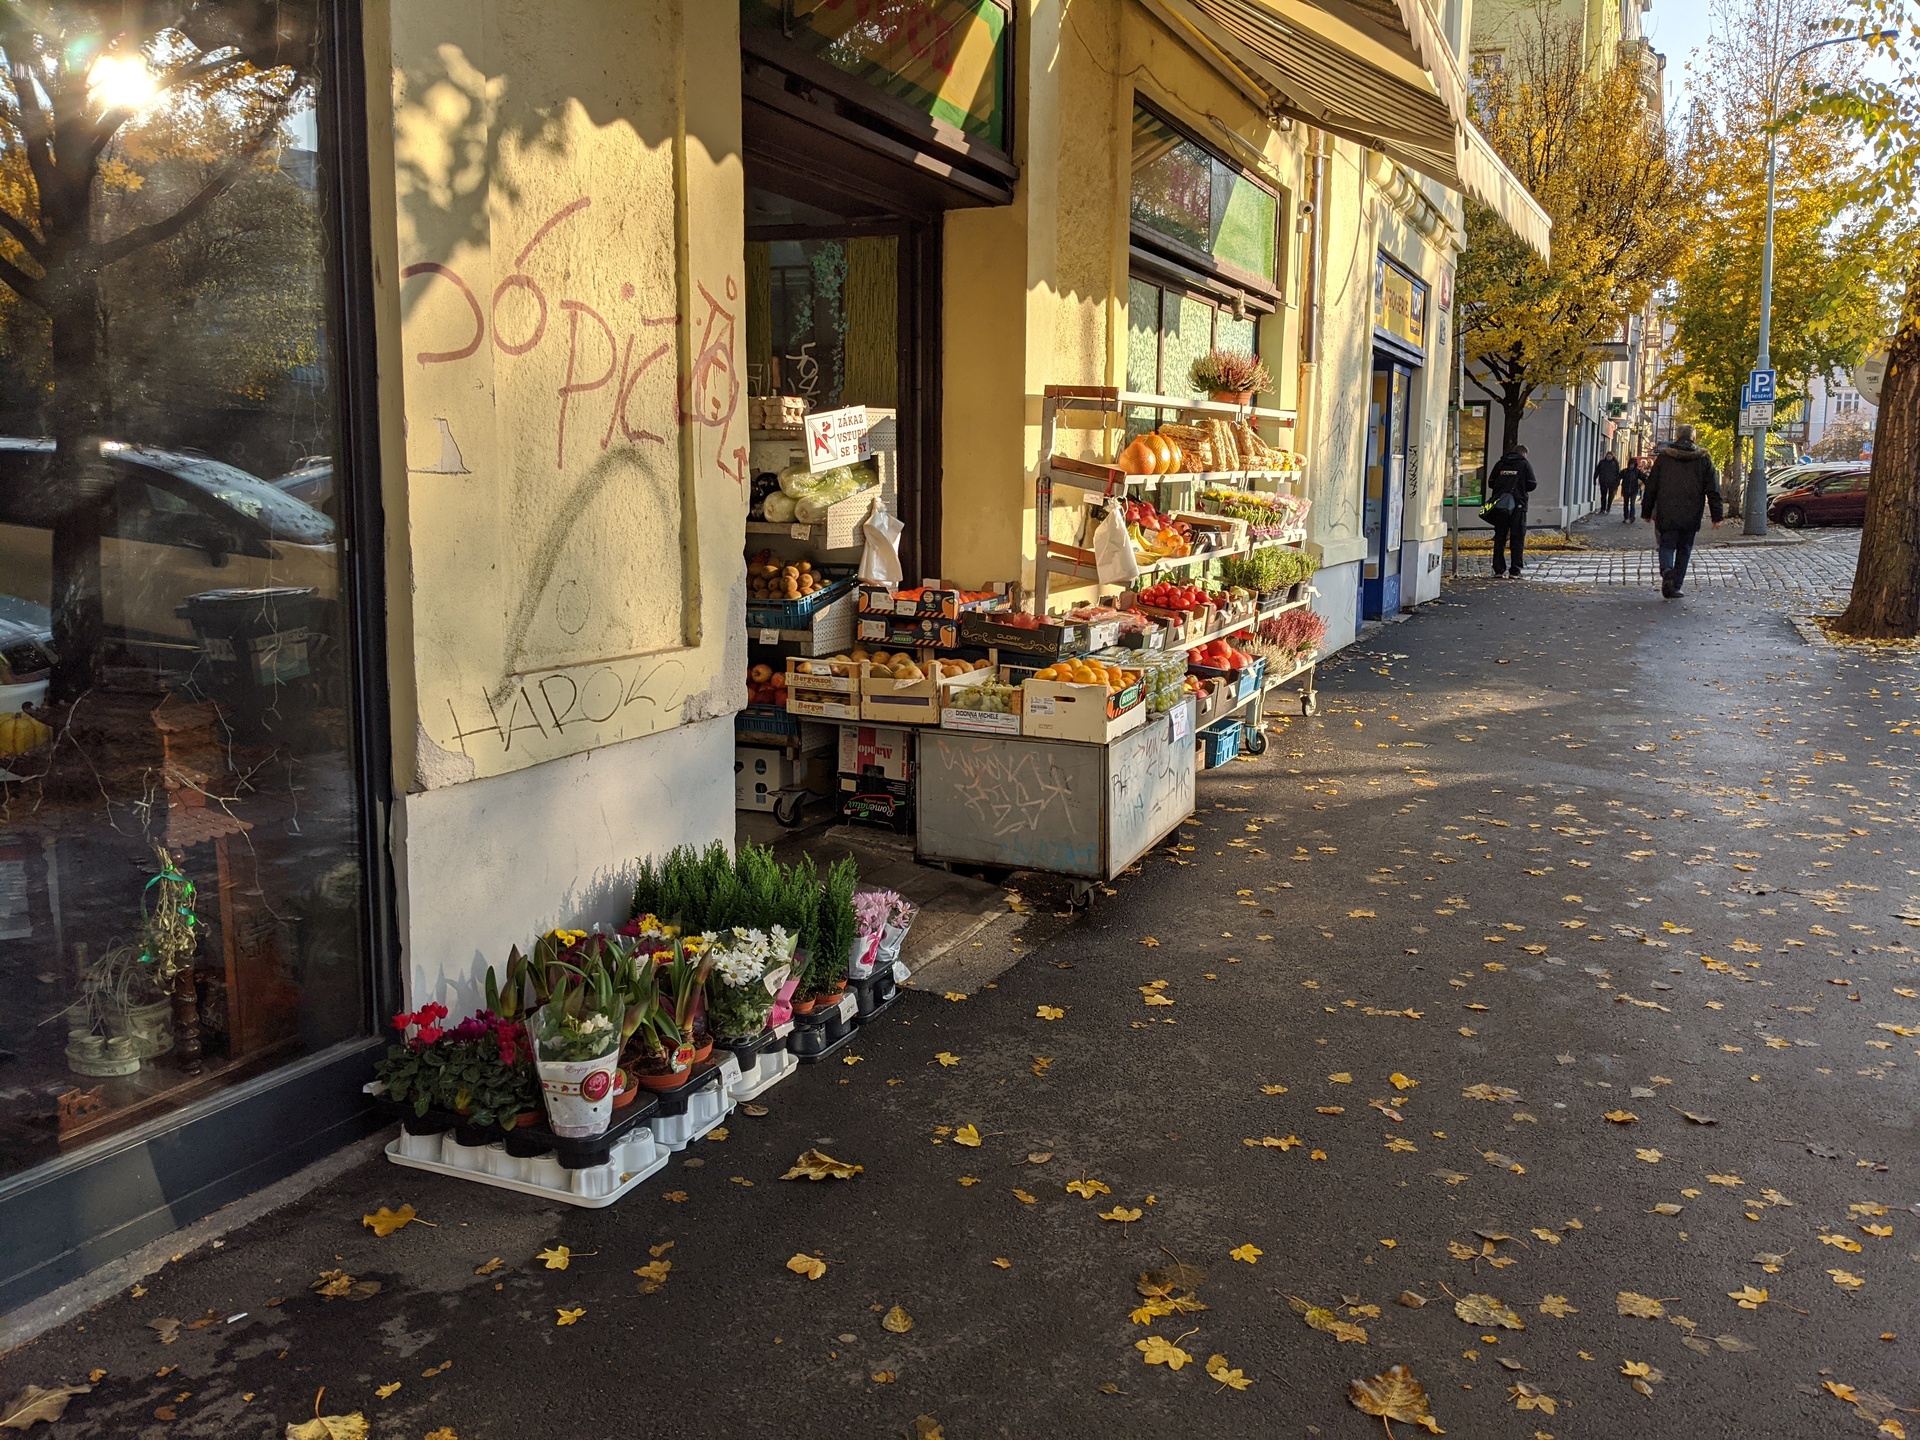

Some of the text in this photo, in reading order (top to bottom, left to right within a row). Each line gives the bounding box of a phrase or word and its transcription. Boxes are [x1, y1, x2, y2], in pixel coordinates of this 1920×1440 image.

[1411, 290, 1421, 315] TOP
[1755, 374, 1770, 392] P
[838, 413, 864, 428] ZÁKAZ
[837, 428, 867, 442] VSTUPU
[841, 442, 867, 457] SE PSY
[978, 712, 999, 720] MICHELE
[565, 1065, 589, 1074] Enjoy
